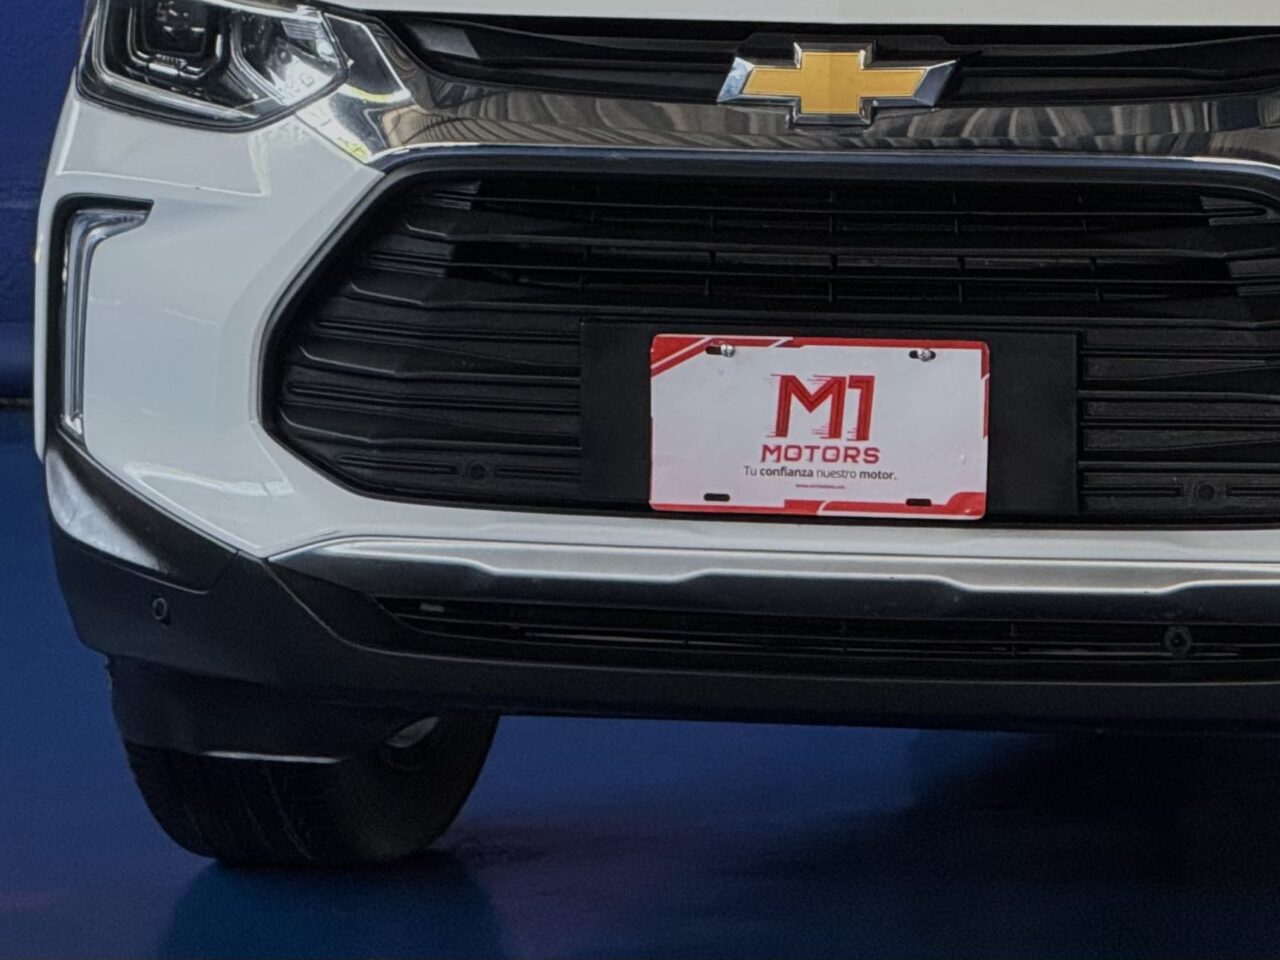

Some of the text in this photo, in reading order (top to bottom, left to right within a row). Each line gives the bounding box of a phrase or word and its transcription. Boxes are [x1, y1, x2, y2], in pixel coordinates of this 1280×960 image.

[765, 373, 876, 442] M1
[760, 444, 881, 465] MOTORS
[743, 465, 898, 481] Tu confianza nuestro motor.
